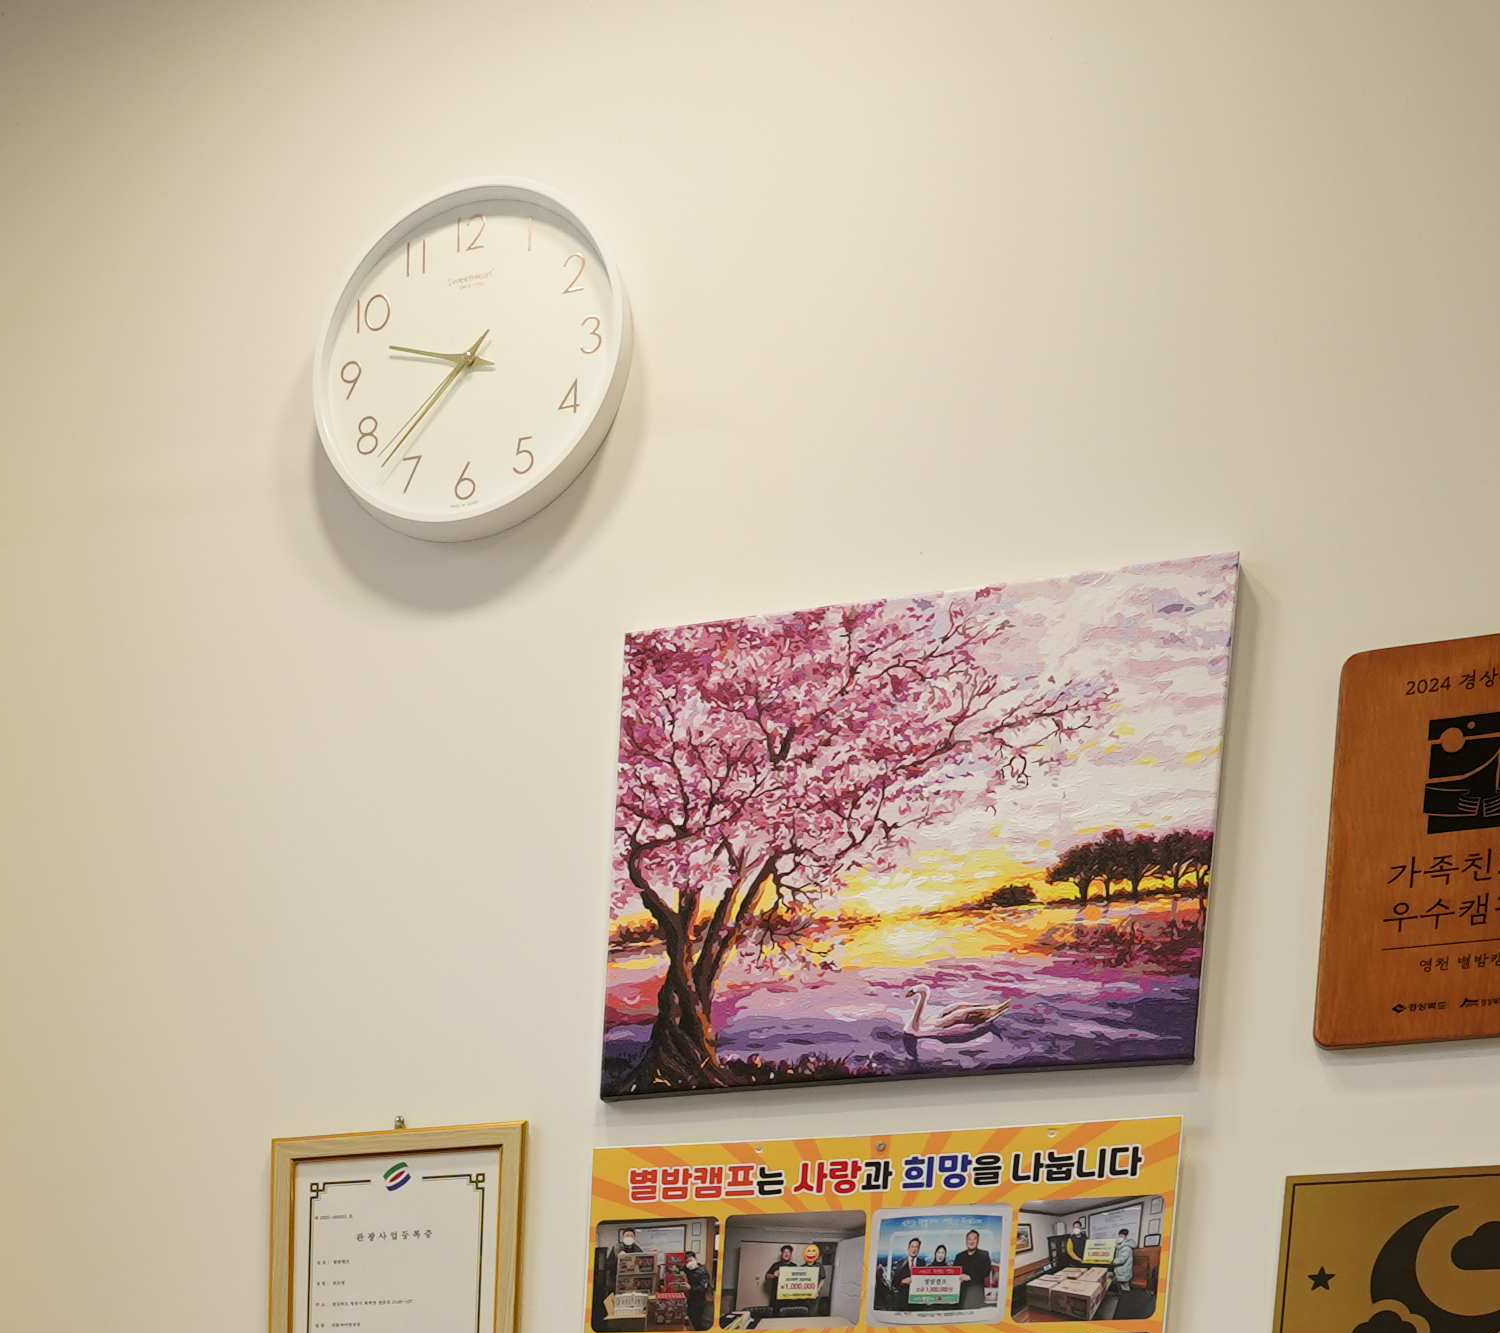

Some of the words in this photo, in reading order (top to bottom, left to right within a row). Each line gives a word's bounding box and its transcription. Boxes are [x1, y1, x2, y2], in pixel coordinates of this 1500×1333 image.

[456, 213, 487, 253] 12
[527, 216, 533, 252] 1
[406, 239, 426, 277] 11
[561, 252, 586, 294] 2
[356, 294, 391, 334] 10
[579, 314, 602, 354] 3
[341, 361, 362, 400] 9
[558, 377, 580, 413] 4
[357, 416, 378, 455] 8
[512, 436, 534, 474] 5
[402, 455, 422, 494] 7
[454, 461, 476, 500] 6
[1405, 675, 1452, 696] 2024
[1419, 955, 1450, 973] 영천
[628, 1161, 785, 1202] 별밤캠프는
[793, 1158, 894, 1196] 사랑과
[902, 1152, 1003, 1192] 희망을
[1010, 1144, 1143, 1184] 나눕니다
